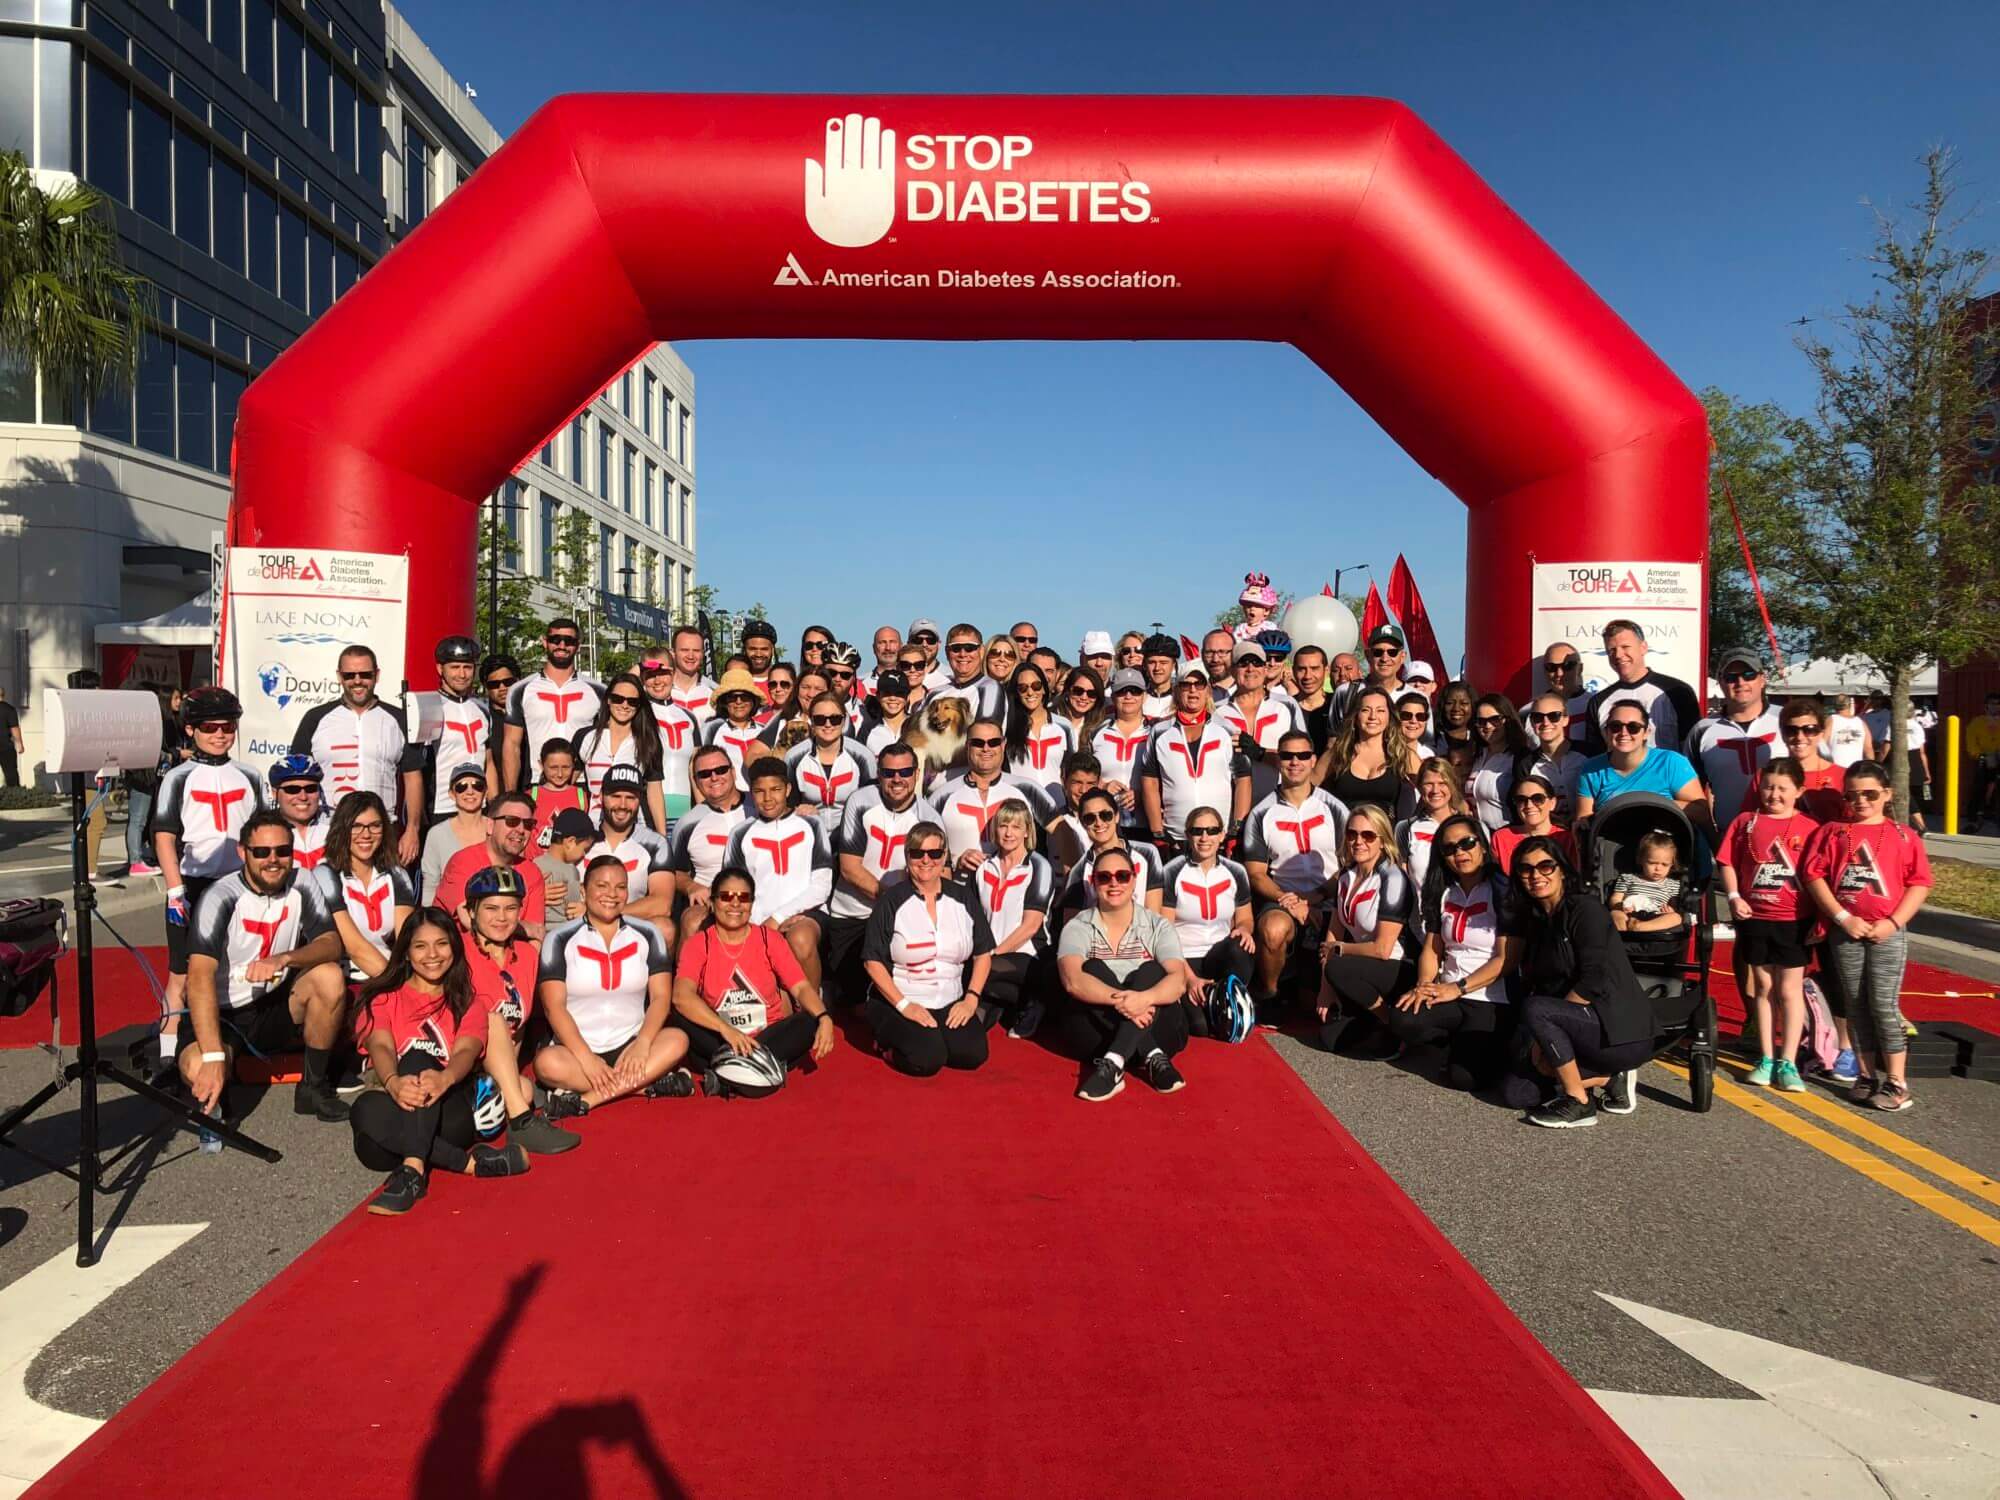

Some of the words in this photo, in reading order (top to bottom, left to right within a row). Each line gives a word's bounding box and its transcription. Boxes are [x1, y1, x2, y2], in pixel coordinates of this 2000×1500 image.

[905, 135, 1033, 171] STOP
[907, 181, 1151, 223] DIABETES
[822, 269, 930, 288] American
[938, 270, 1035, 288] Diabetes
[1041, 269, 1176, 288] Association
[258, 555, 296, 568] TOUR
[330, 557, 375, 568] American
[262, 566, 301, 580] CURE
[330, 566, 370, 576] Diabetes
[1567, 569, 1613, 581] TOUR
[1647, 568, 1681, 577] American
[330, 575, 384, 585] Association
[1647, 577, 1678, 585] Diabetes
[1572, 580, 1617, 594] CURE
[256, 611, 297, 628] LAKE
[303, 612, 369, 628] NONA
[1565, 625, 1603, 638] LAK
[1646, 625, 1678, 638] ONA
[611, 768, 639, 784] NONA
[731, 1013, 752, 1026] 851
